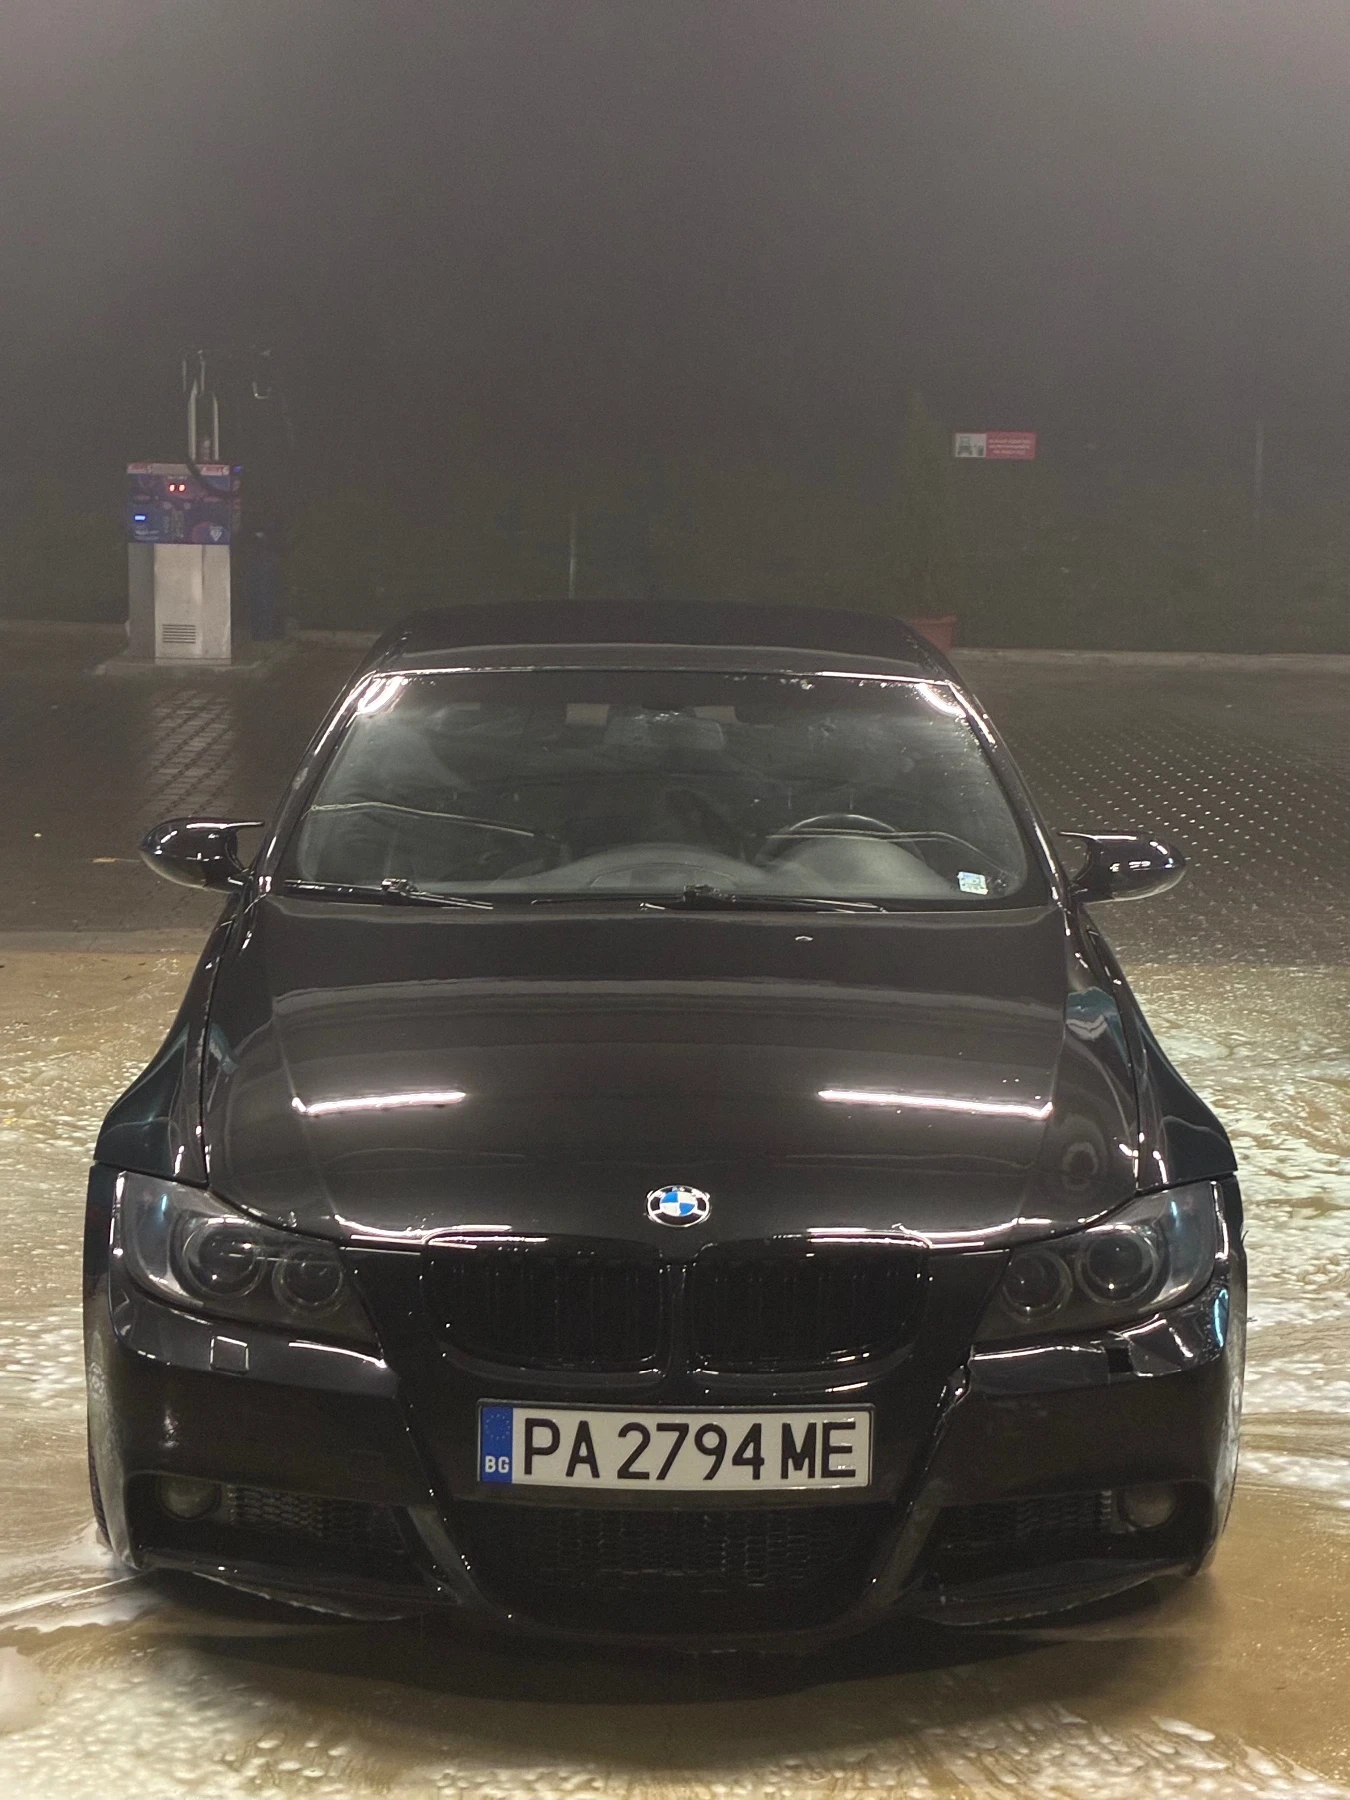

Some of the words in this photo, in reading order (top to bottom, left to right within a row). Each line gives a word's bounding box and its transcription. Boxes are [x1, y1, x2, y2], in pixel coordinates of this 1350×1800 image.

[485, 1456, 510, 1474] BG
[524, 1418, 600, 1478] PA
[617, 1422, 765, 1480] 2794
[780, 1421, 857, 1479] ME
